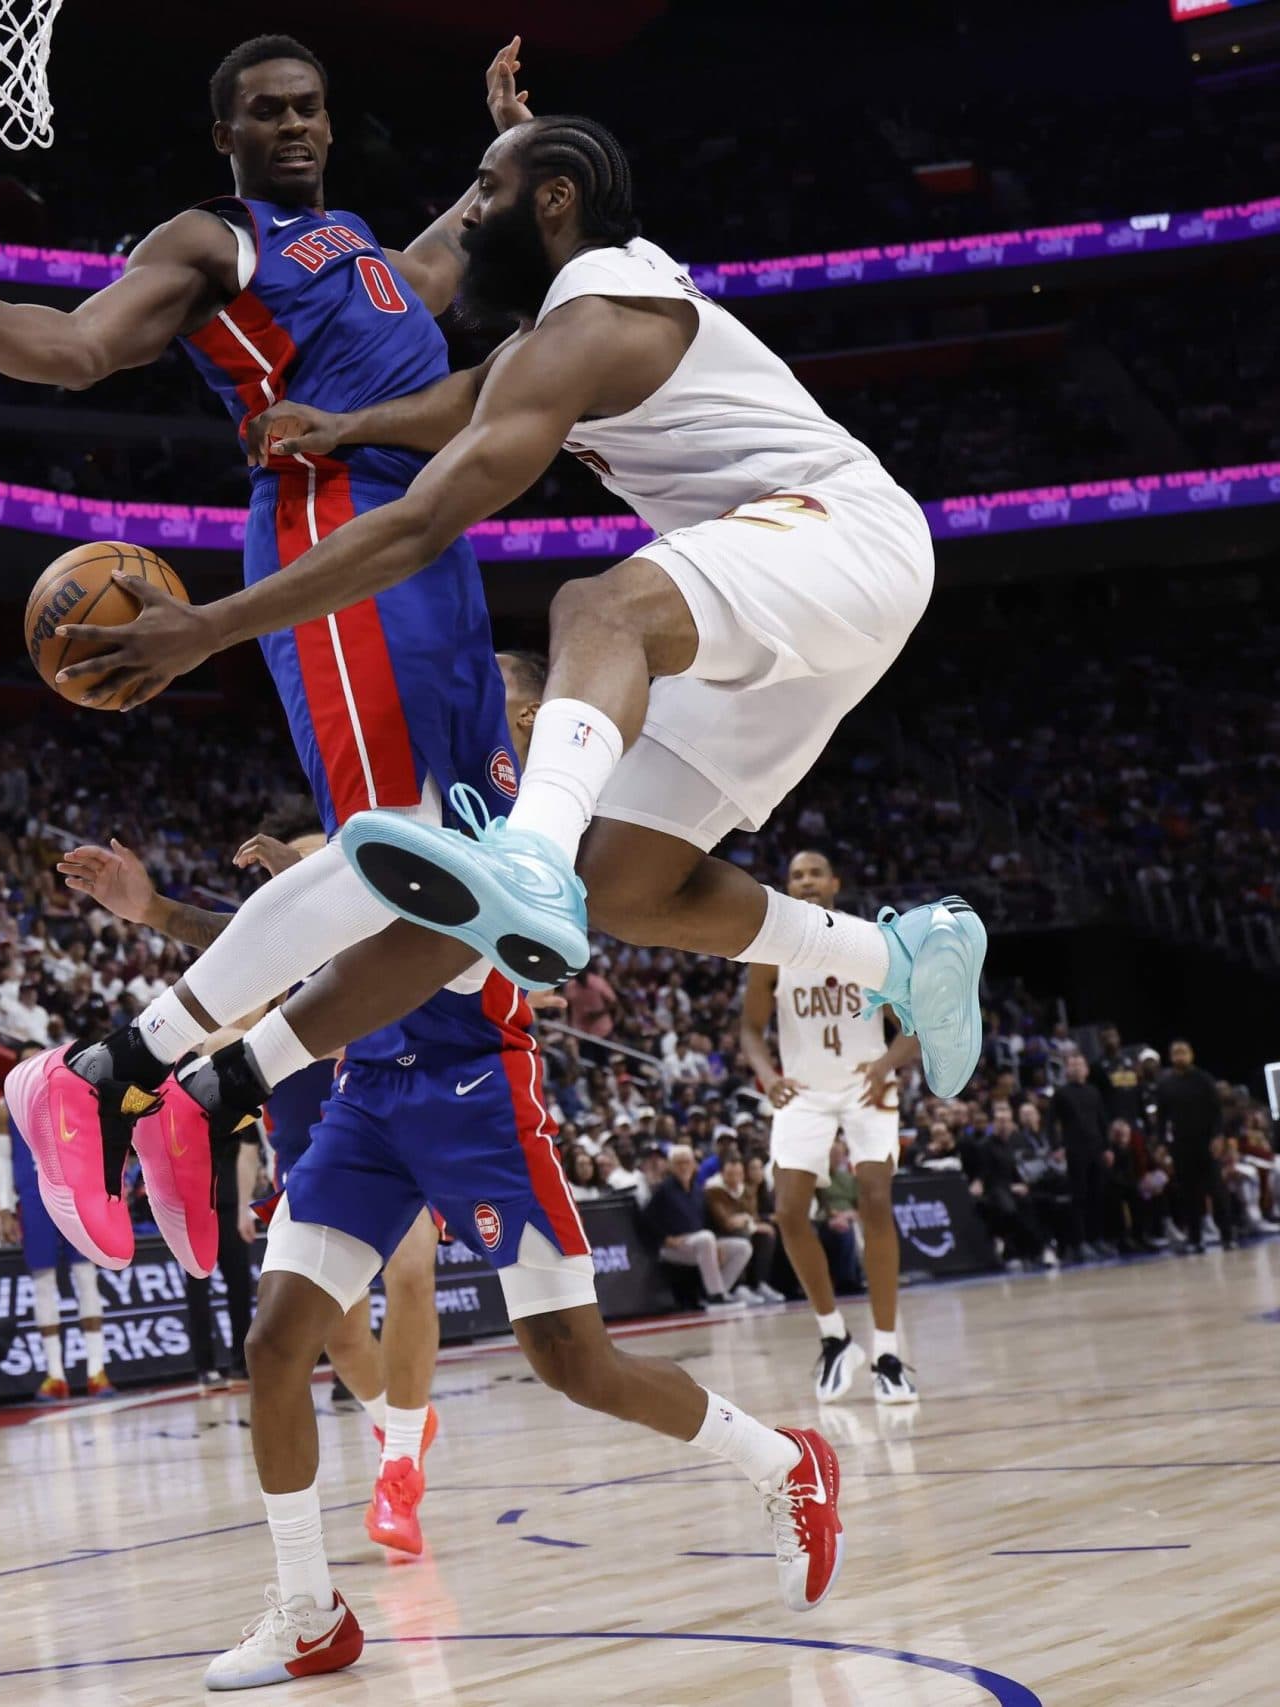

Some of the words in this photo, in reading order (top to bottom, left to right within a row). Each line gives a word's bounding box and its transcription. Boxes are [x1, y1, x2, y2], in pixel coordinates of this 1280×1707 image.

[356, 255, 408, 313] 0
[31, 578, 89, 668] Wilso
[792, 982, 863, 1018] CAVS
[822, 1023, 843, 1058] 4
